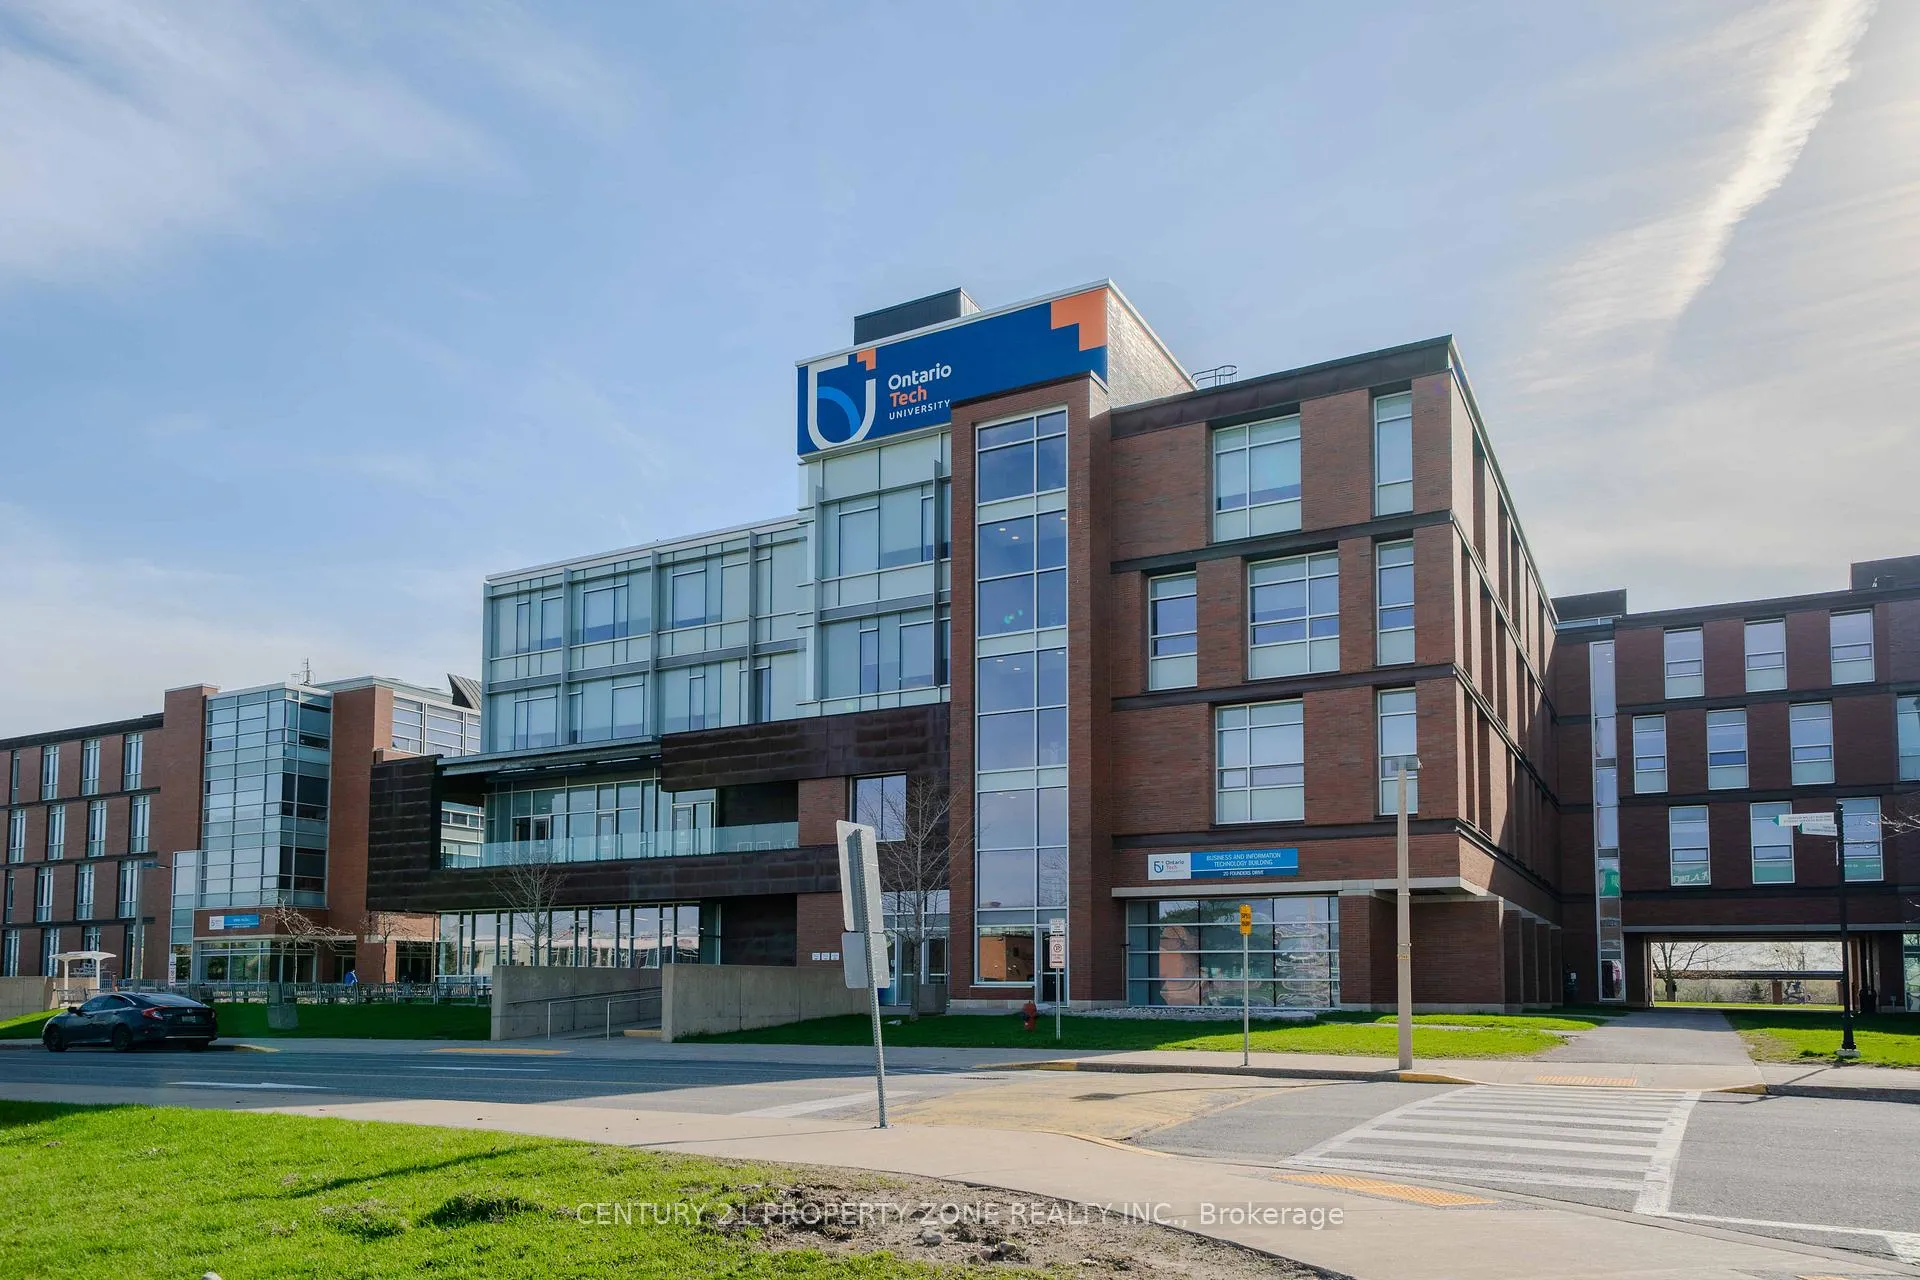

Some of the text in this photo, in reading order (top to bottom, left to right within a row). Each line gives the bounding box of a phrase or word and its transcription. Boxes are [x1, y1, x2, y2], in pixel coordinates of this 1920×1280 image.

[888, 363, 952, 390] Ontario
[890, 385, 927, 408] Tech
[889, 399, 951, 420] UNIVERSITY
[1214, 860, 1248, 868] TECHNOLOGY
[1245, 852, 1281, 860] INFORMATION
